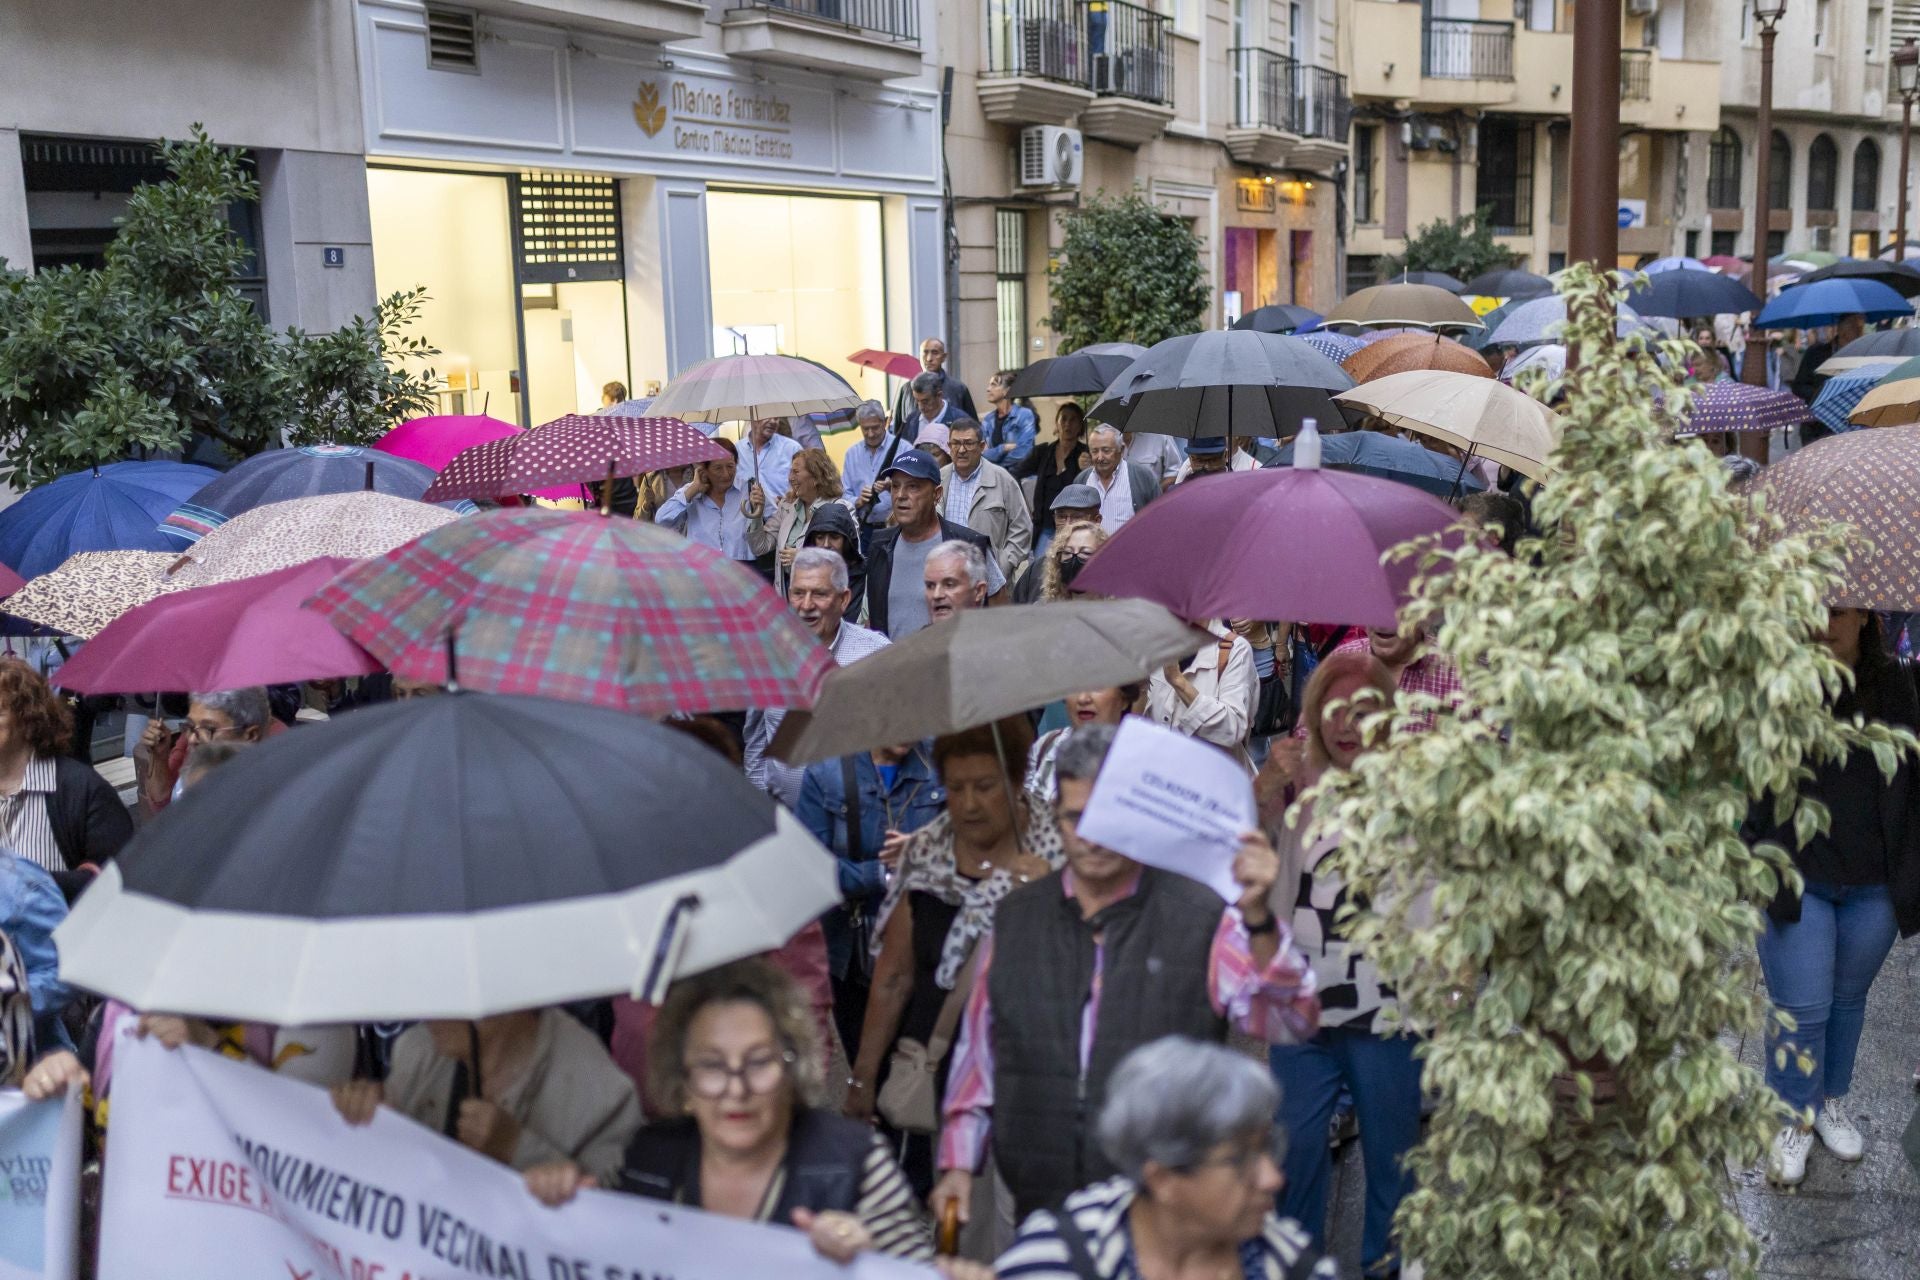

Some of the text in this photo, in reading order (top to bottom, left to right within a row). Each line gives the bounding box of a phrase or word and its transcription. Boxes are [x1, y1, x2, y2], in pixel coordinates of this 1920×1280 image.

[672, 81, 722, 117] Marina
[674, 125, 710, 152] Centro
[330, 250, 337, 262] 8
